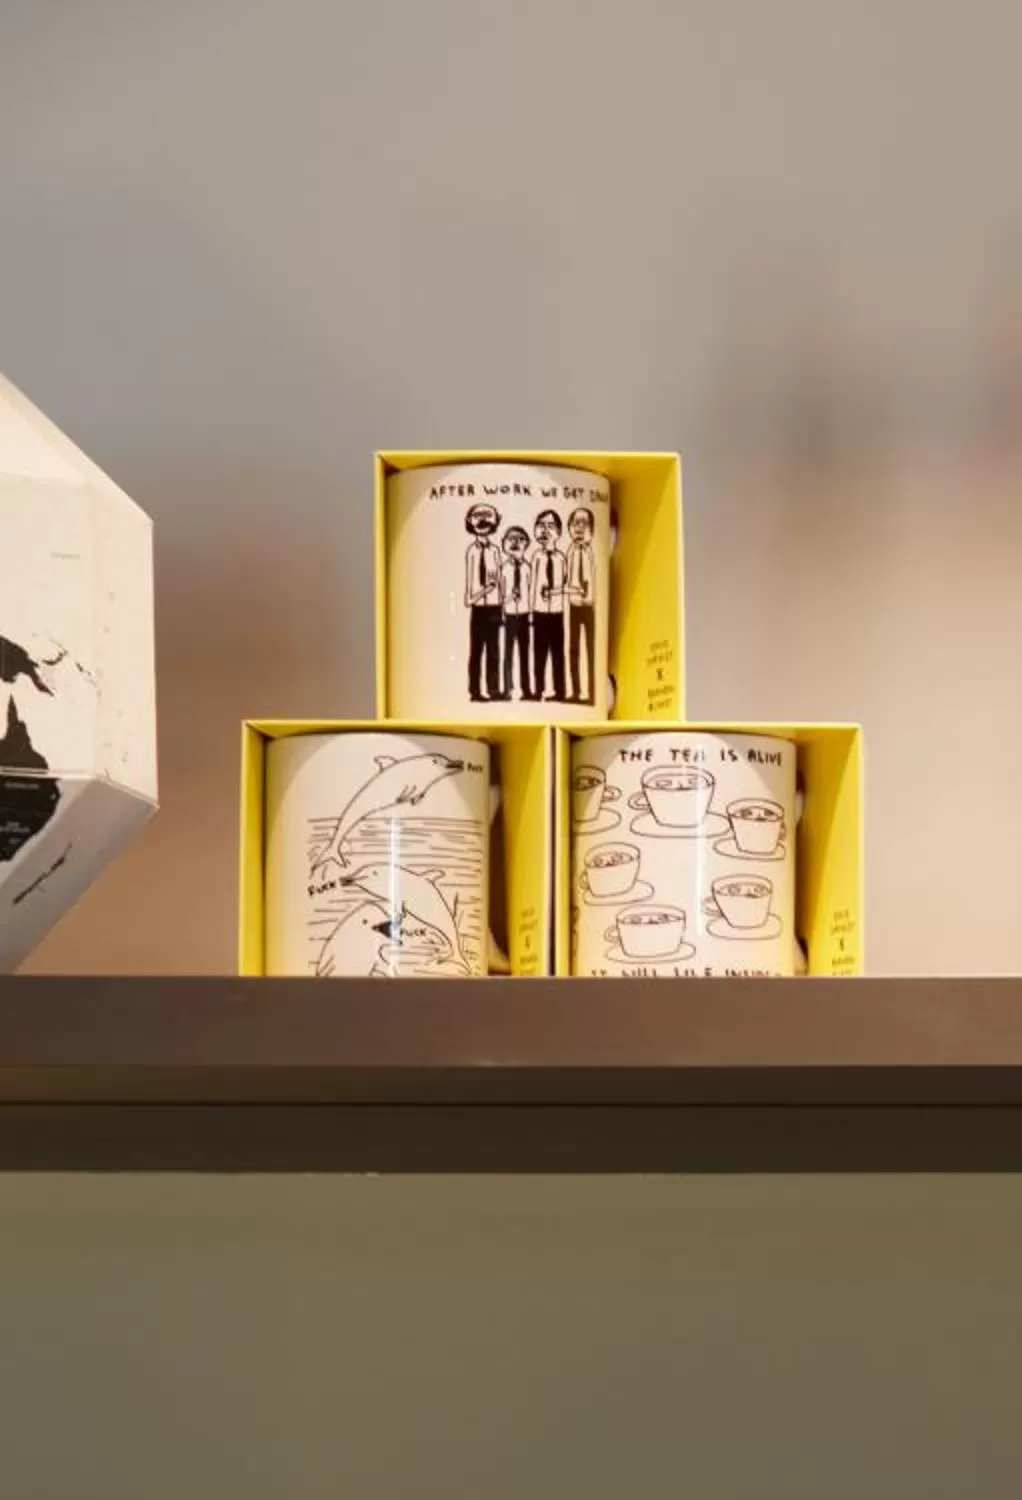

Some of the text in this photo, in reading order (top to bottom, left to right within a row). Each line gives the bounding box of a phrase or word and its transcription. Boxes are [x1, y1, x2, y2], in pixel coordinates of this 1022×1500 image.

[430, 484, 475, 499] AFTER
[483, 484, 531, 496] WORK
[541, 487, 558, 498] WE
[563, 486, 584, 499] GET
[619, 749, 653, 763] THE
[670, 749, 705, 763] TEA
[720, 749, 738, 762] IS
